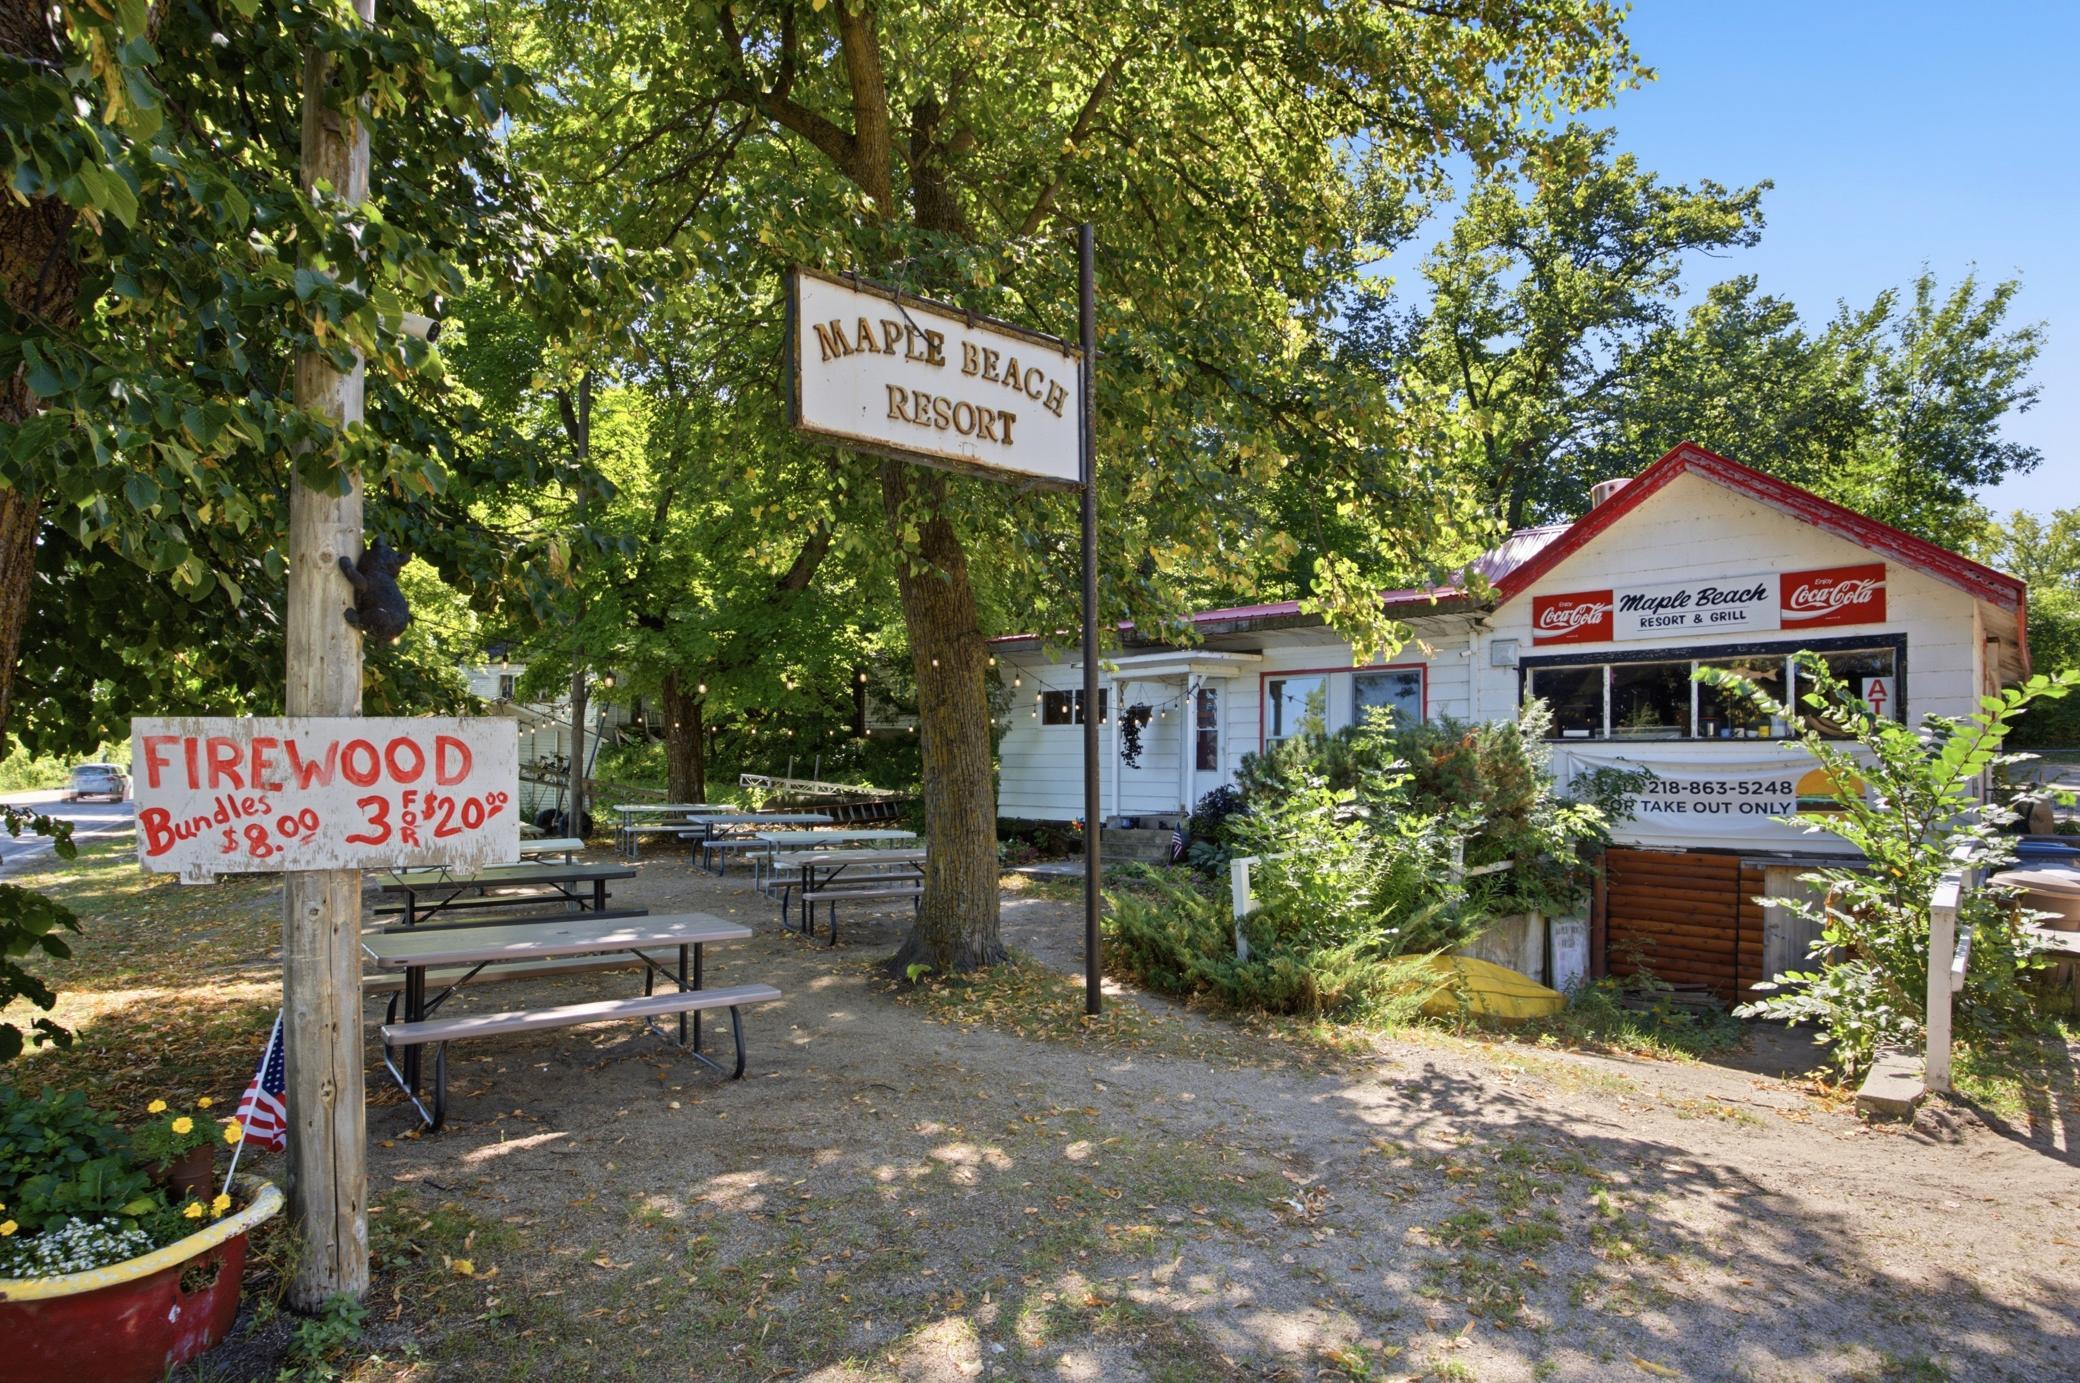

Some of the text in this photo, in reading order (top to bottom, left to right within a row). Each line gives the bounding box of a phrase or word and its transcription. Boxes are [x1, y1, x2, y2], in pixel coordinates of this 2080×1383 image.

[813, 317, 1069, 418] MAPLE BEACH
[886, 383, 1017, 445] RESORT
[1619, 582, 1768, 615] Maple Beach
[1790, 579, 1875, 609] Coca-Cola
[1540, 602, 1606, 628] Coca-Cola
[1640, 610, 1747, 628] RESORT & GRILL
[142, 735, 472, 791] FIREWOOD
[1641, 800, 1688, 813] TAKE
[1693, 801, 1733, 814] OUT
[1739, 802, 1792, 815] ONLY
[1649, 781, 1793, 795] 218-863-5248
[139, 794, 272, 856] Bundles
[220, 808, 320, 858] $8.00
[345, 795, 392, 846] 3
[400, 790, 420, 848] FOR
